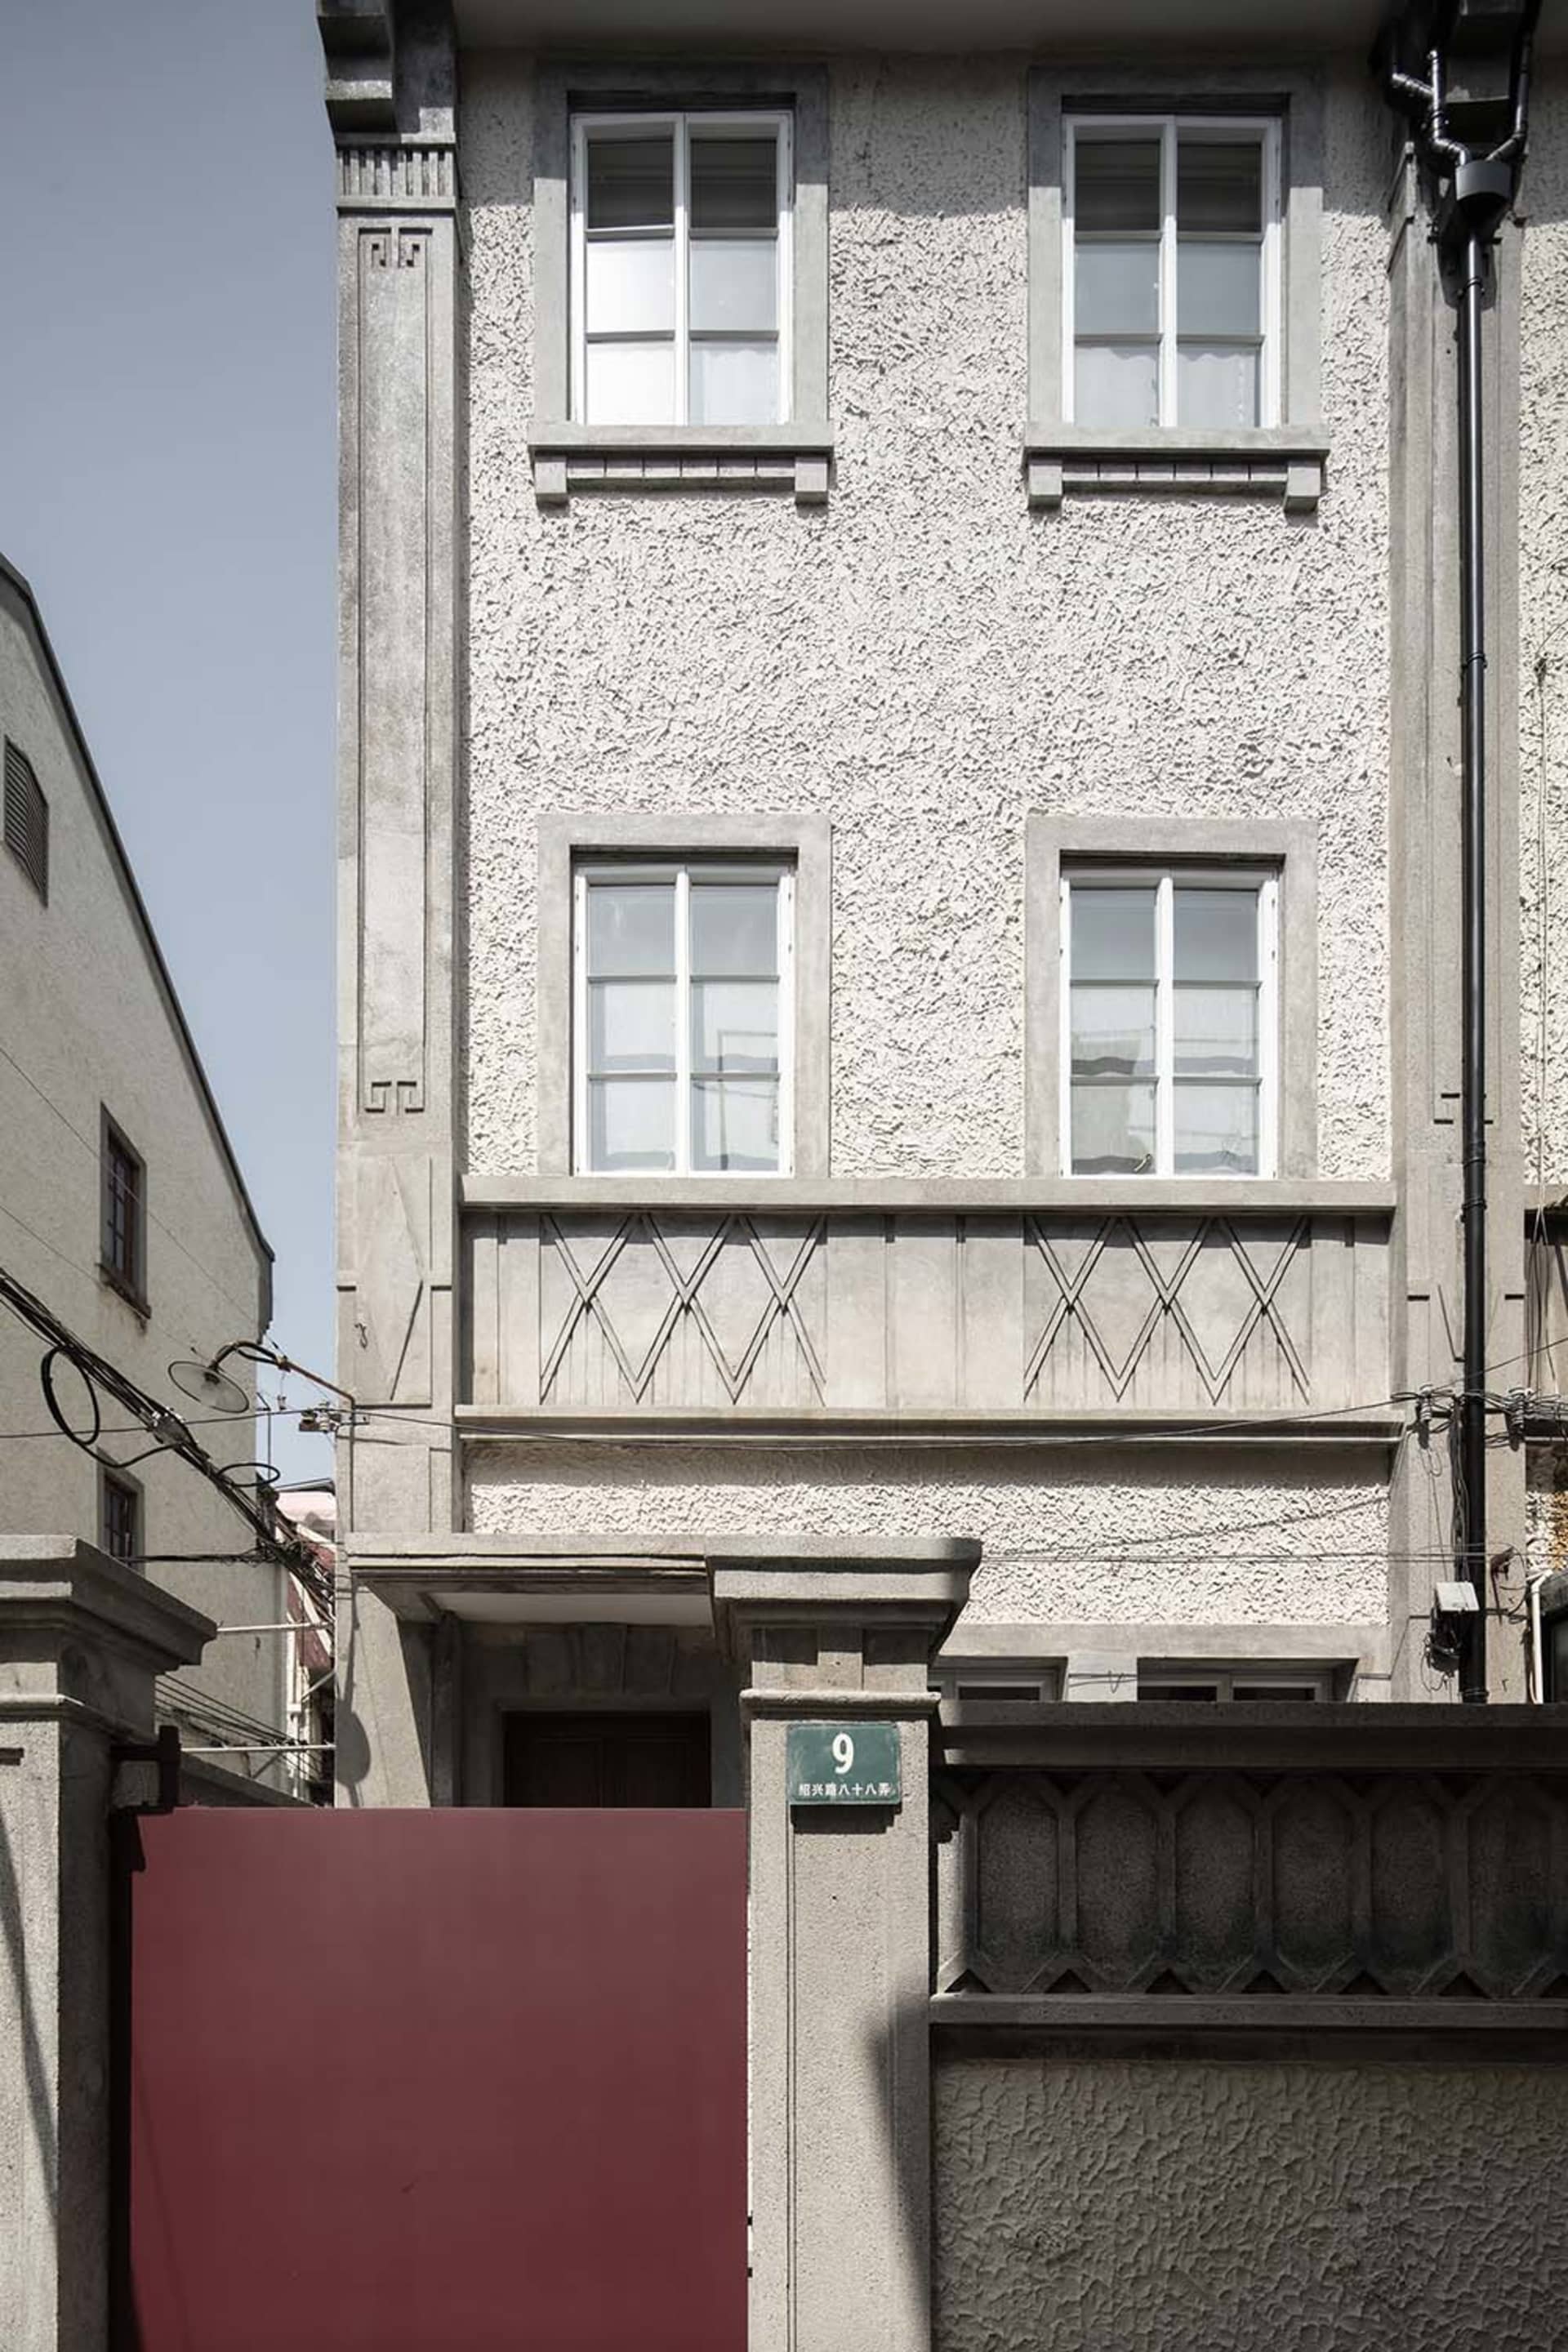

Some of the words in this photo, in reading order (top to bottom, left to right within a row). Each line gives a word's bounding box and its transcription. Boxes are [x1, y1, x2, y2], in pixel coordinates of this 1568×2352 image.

[832, 1732, 853, 1774] 9
[799, 1782, 891, 1797] 绍兴路八十八弄
